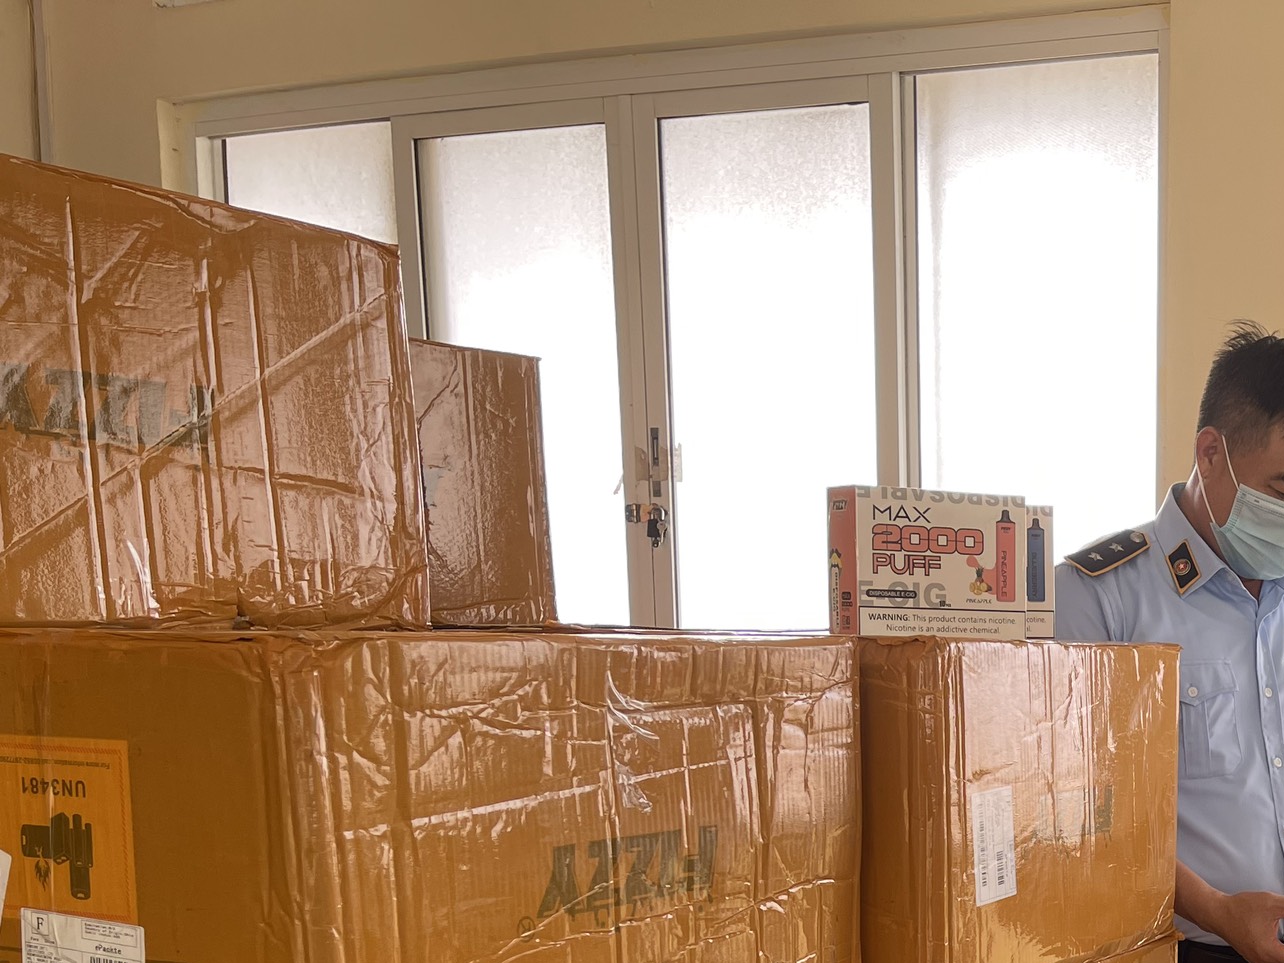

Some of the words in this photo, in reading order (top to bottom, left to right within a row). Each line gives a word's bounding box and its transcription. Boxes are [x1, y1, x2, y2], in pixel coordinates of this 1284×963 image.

[873, 504, 931, 523] MAX
[872, 523, 984, 555] 2000
[872, 553, 941, 576] PUFF
[868, 613, 910, 622] WARNING:
[928, 615, 956, 624] product
[886, 624, 917, 632] Nicotine
[21, 776, 86, 798] UN3481
[36, 916, 45, 931] F
